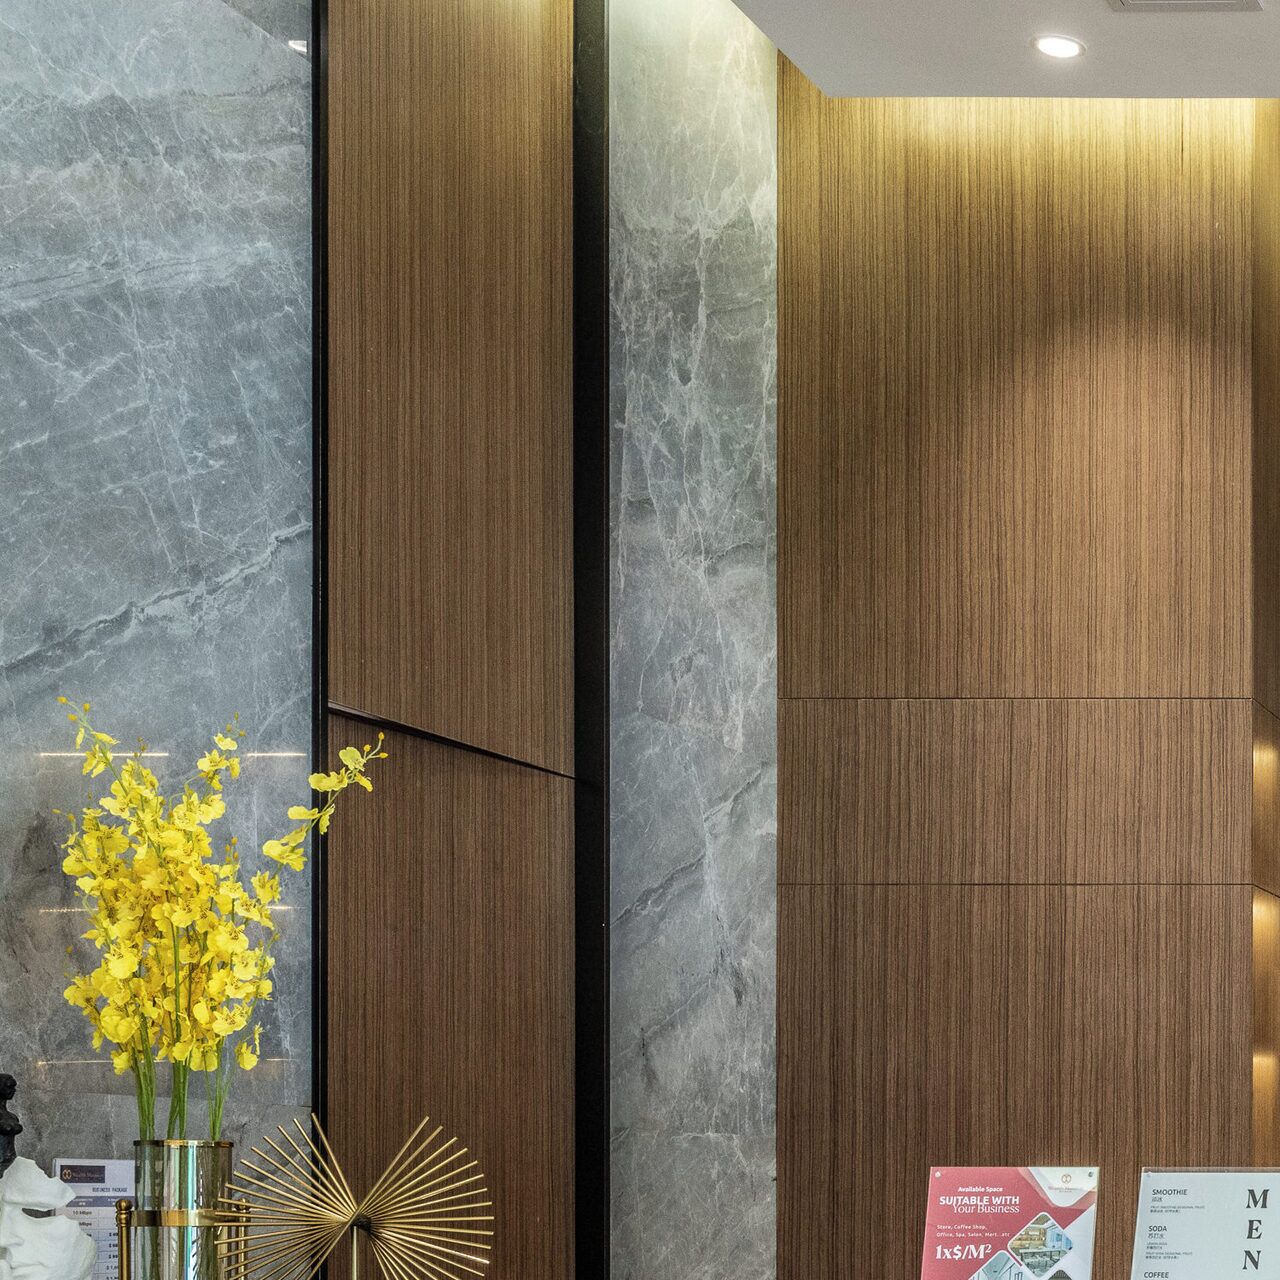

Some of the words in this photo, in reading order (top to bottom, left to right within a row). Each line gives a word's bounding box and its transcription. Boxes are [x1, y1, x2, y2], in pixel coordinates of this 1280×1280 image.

[939, 1196, 989, 1205] SUITABLE
[992, 1196, 1020, 1204] WITH
[952, 1204, 976, 1214] Your
[977, 1204, 1020, 1214] Business
